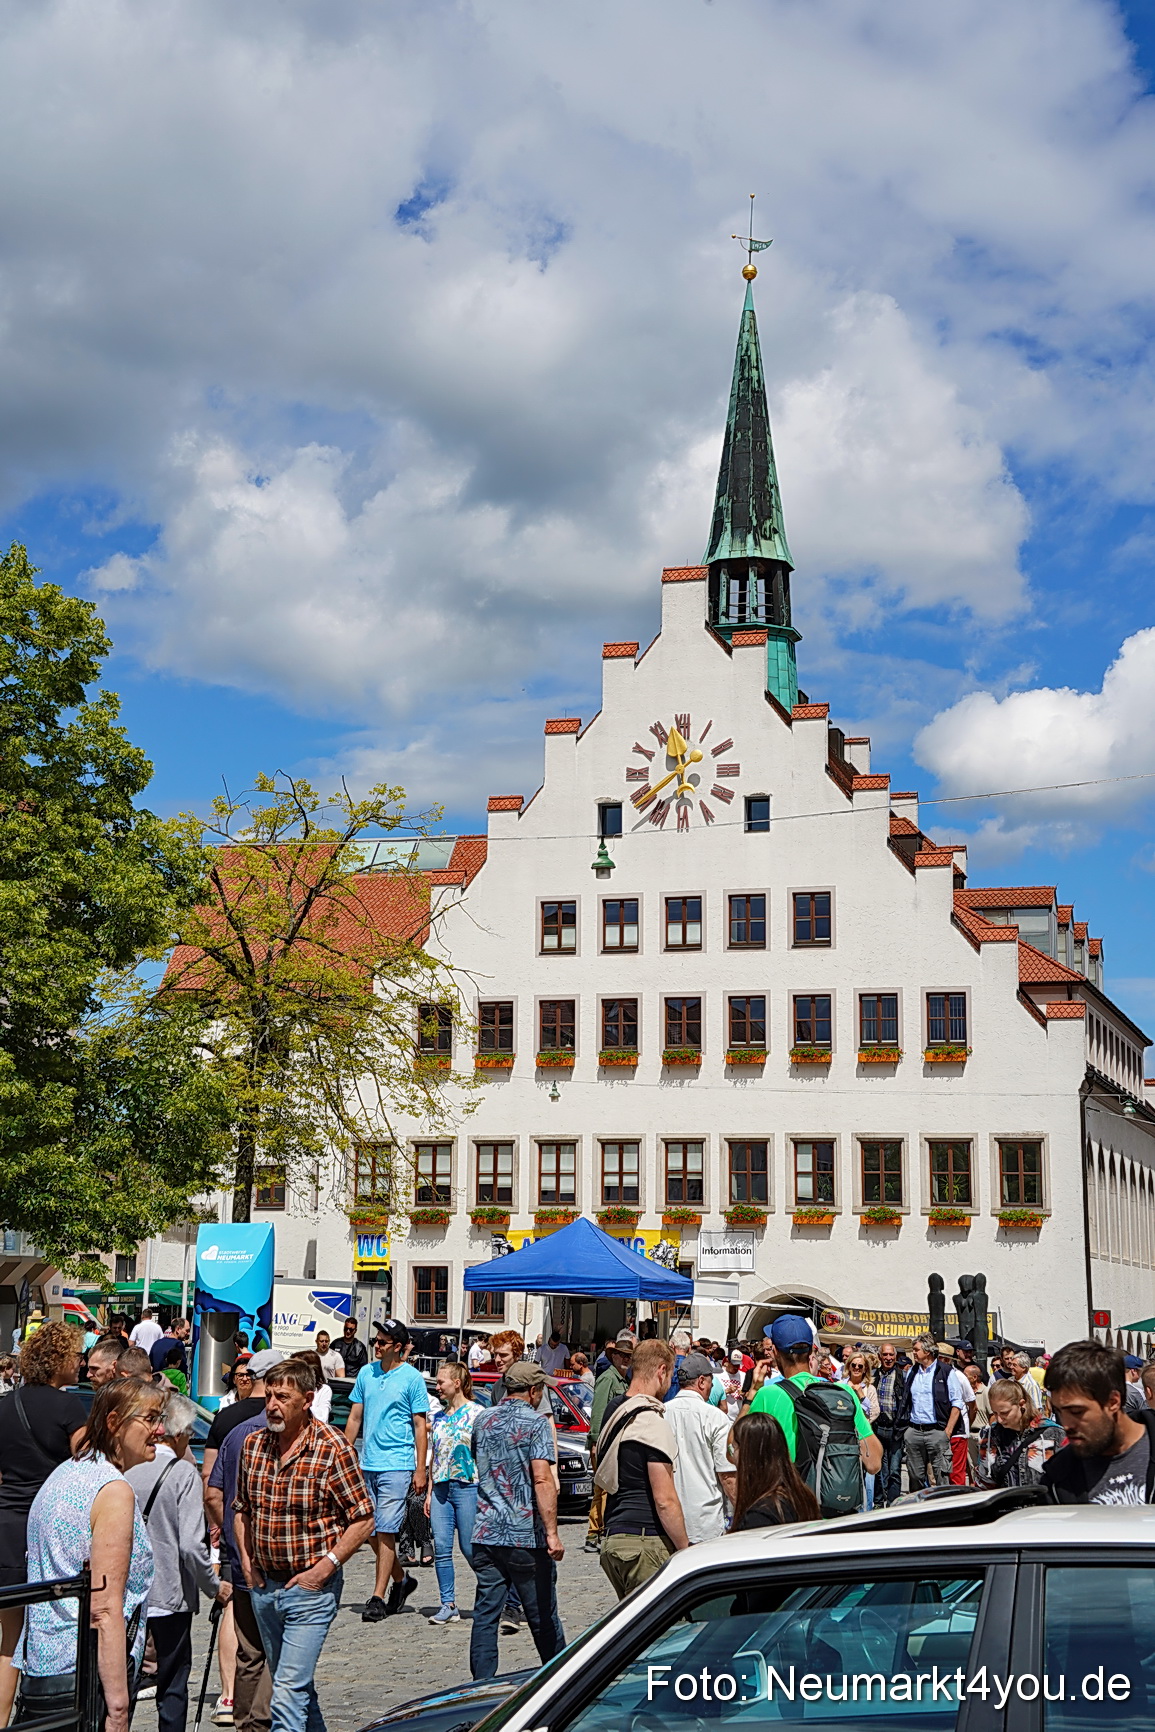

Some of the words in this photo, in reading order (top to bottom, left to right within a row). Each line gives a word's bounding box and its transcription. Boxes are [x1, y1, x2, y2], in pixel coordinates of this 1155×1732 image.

[357, 1233, 388, 1258] WC
[702, 1246, 752, 1255] Information
[217, 1253, 254, 1261] NEUMARKT
[848, 1309, 857, 1321] 1.
[876, 1323, 930, 1338] NEUMARK
